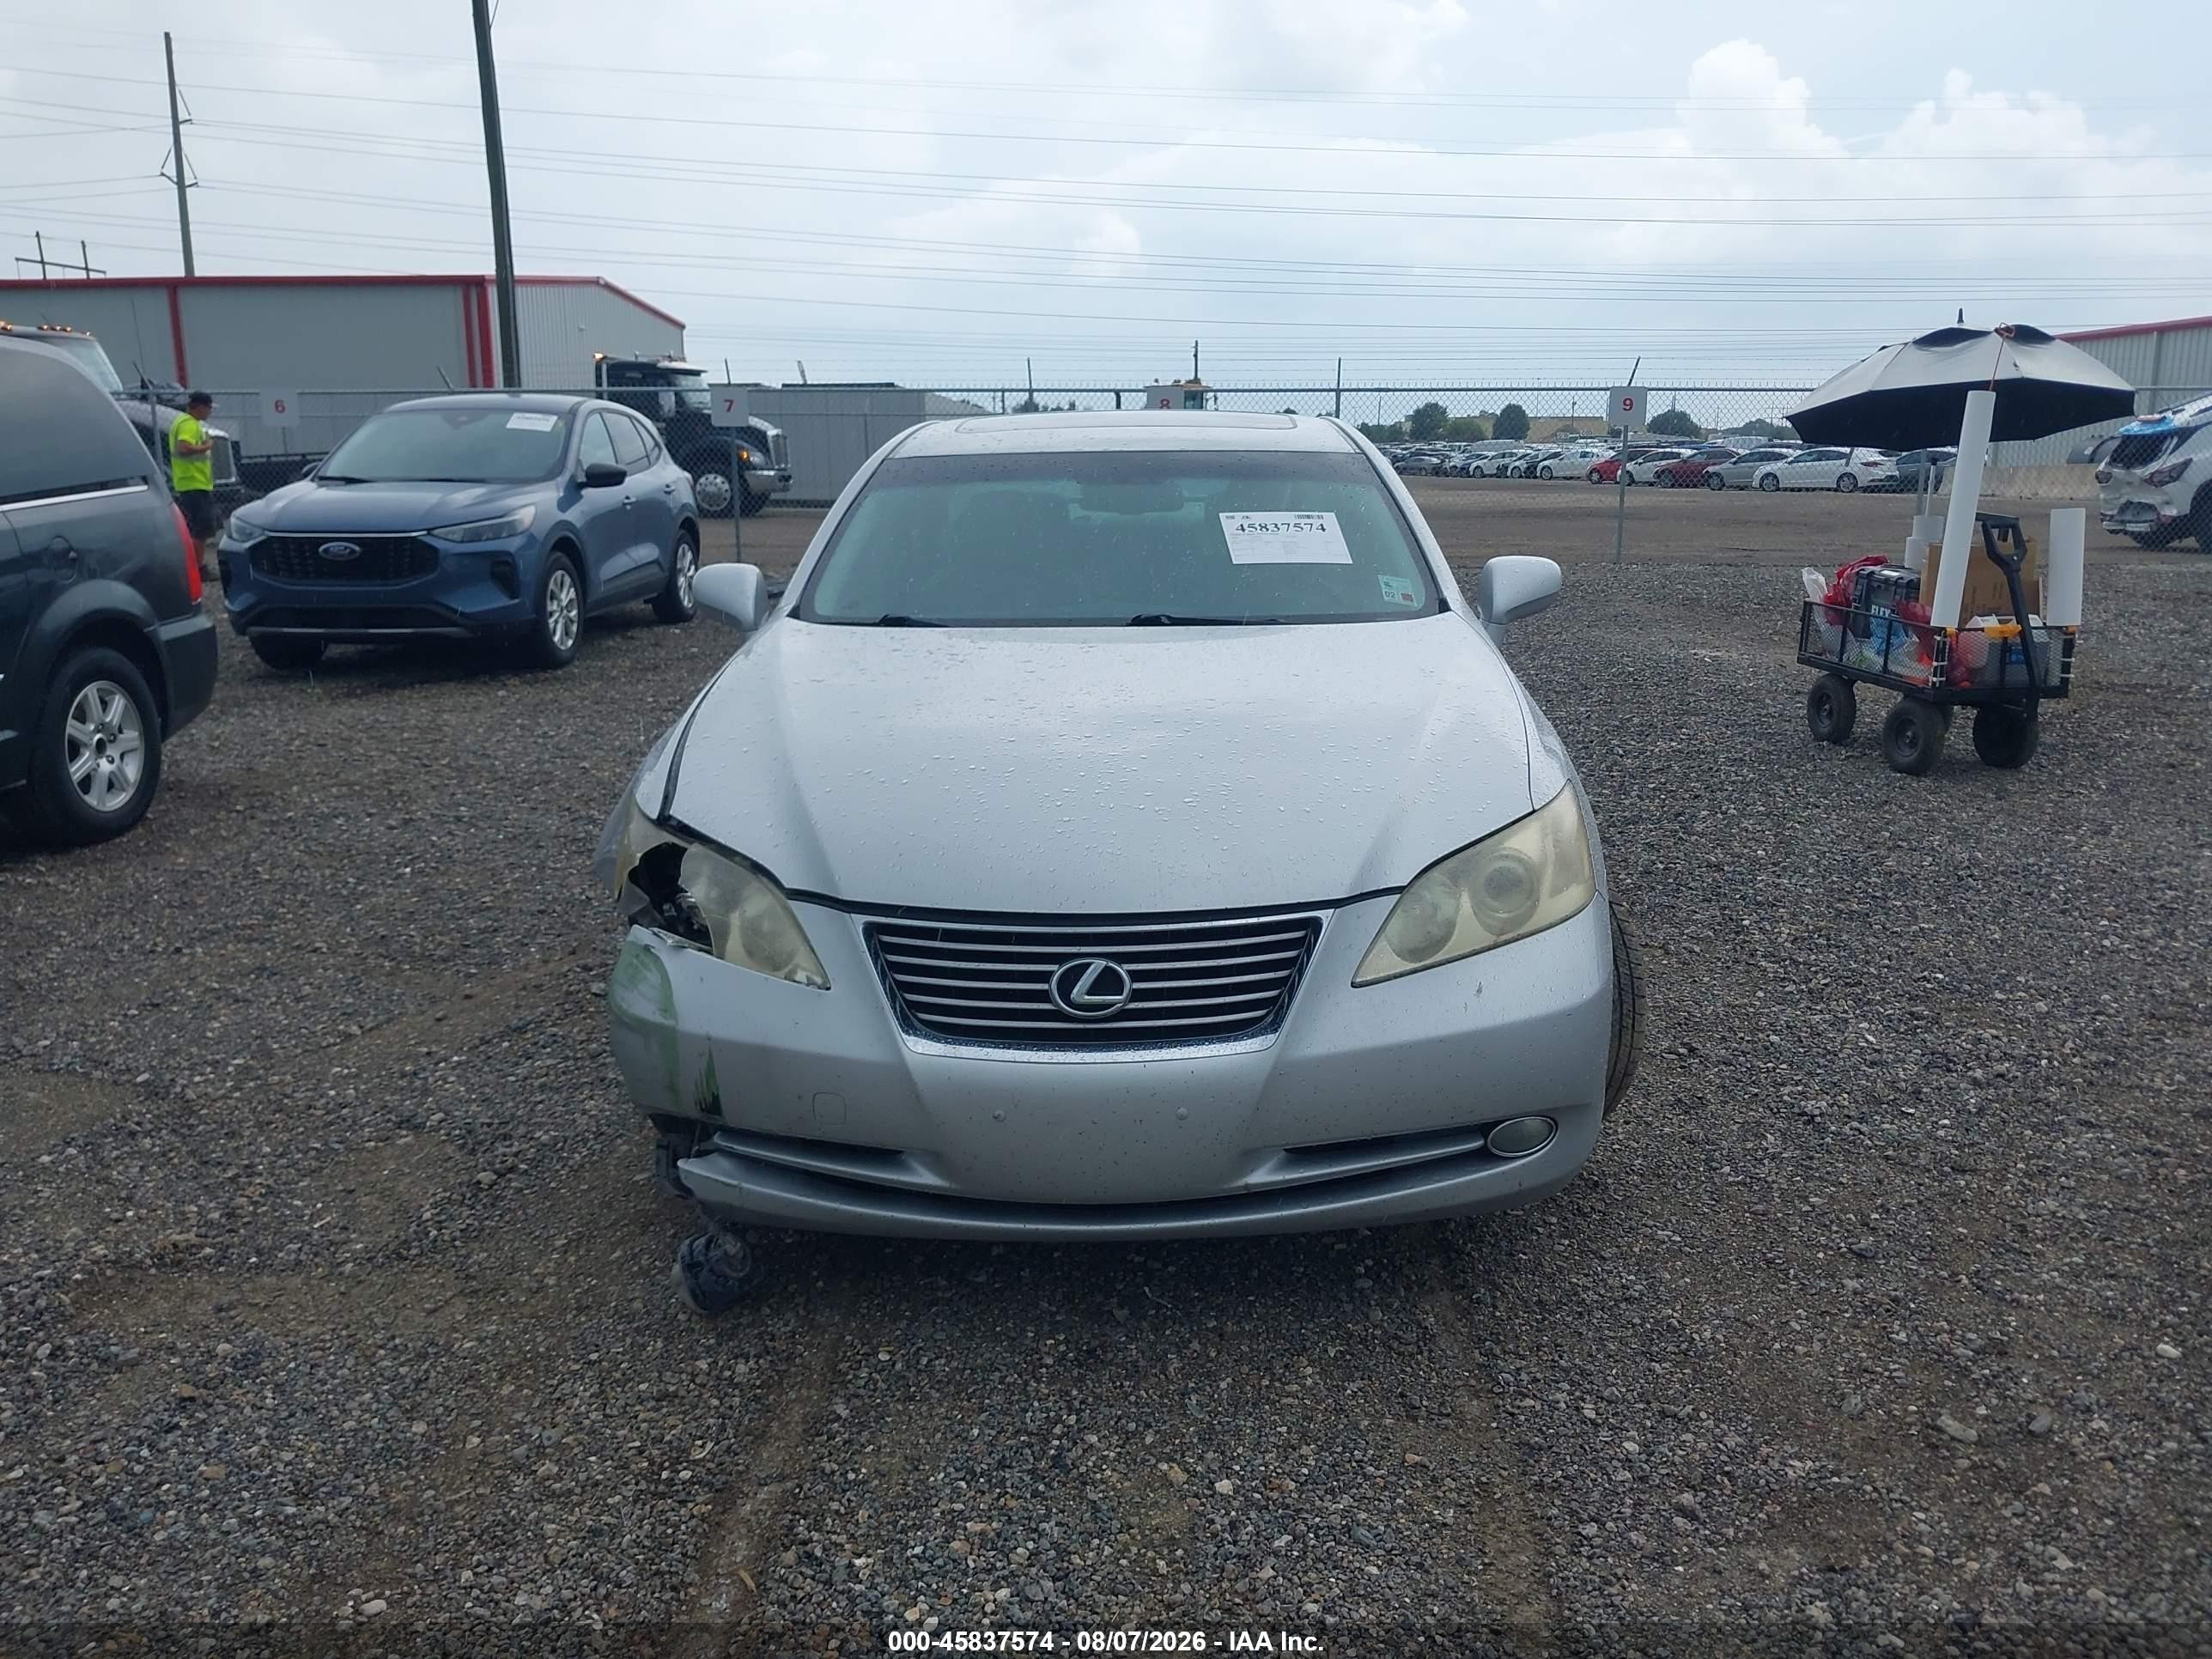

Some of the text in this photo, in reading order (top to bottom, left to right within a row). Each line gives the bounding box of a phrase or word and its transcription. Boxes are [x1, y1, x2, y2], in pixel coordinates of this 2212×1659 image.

[275, 399, 285, 413] 6
[724, 398, 734, 413] 7
[1622, 398, 1633, 411] 9
[1236, 522, 1327, 533] 45837574
